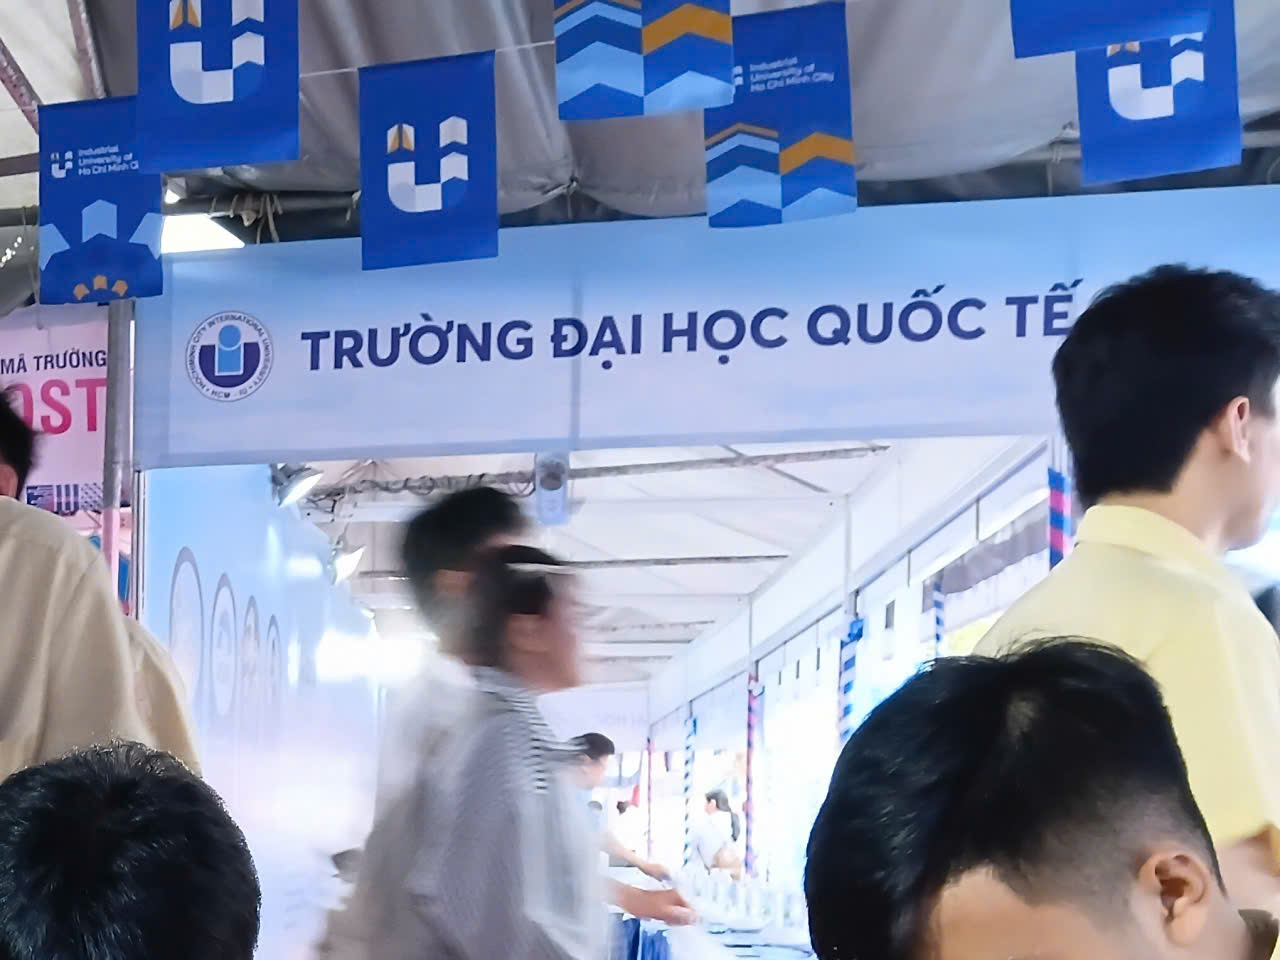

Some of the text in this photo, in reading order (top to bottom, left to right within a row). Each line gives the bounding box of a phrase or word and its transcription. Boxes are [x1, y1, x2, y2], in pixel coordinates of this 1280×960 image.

[750, 66, 802, 81] University
[78, 144, 119, 156] Industrial
[78, 152, 133, 166] University of
[78, 167, 91, 176] Ho
[92, 165, 107, 174] Chi
[108, 162, 129, 172] Minh
[301, 278, 1084, 371] TRƯỜNG ĐẠI HỌC QUỐC TẾ
[0, 347, 107, 375] MÃ TRƯỜNG
